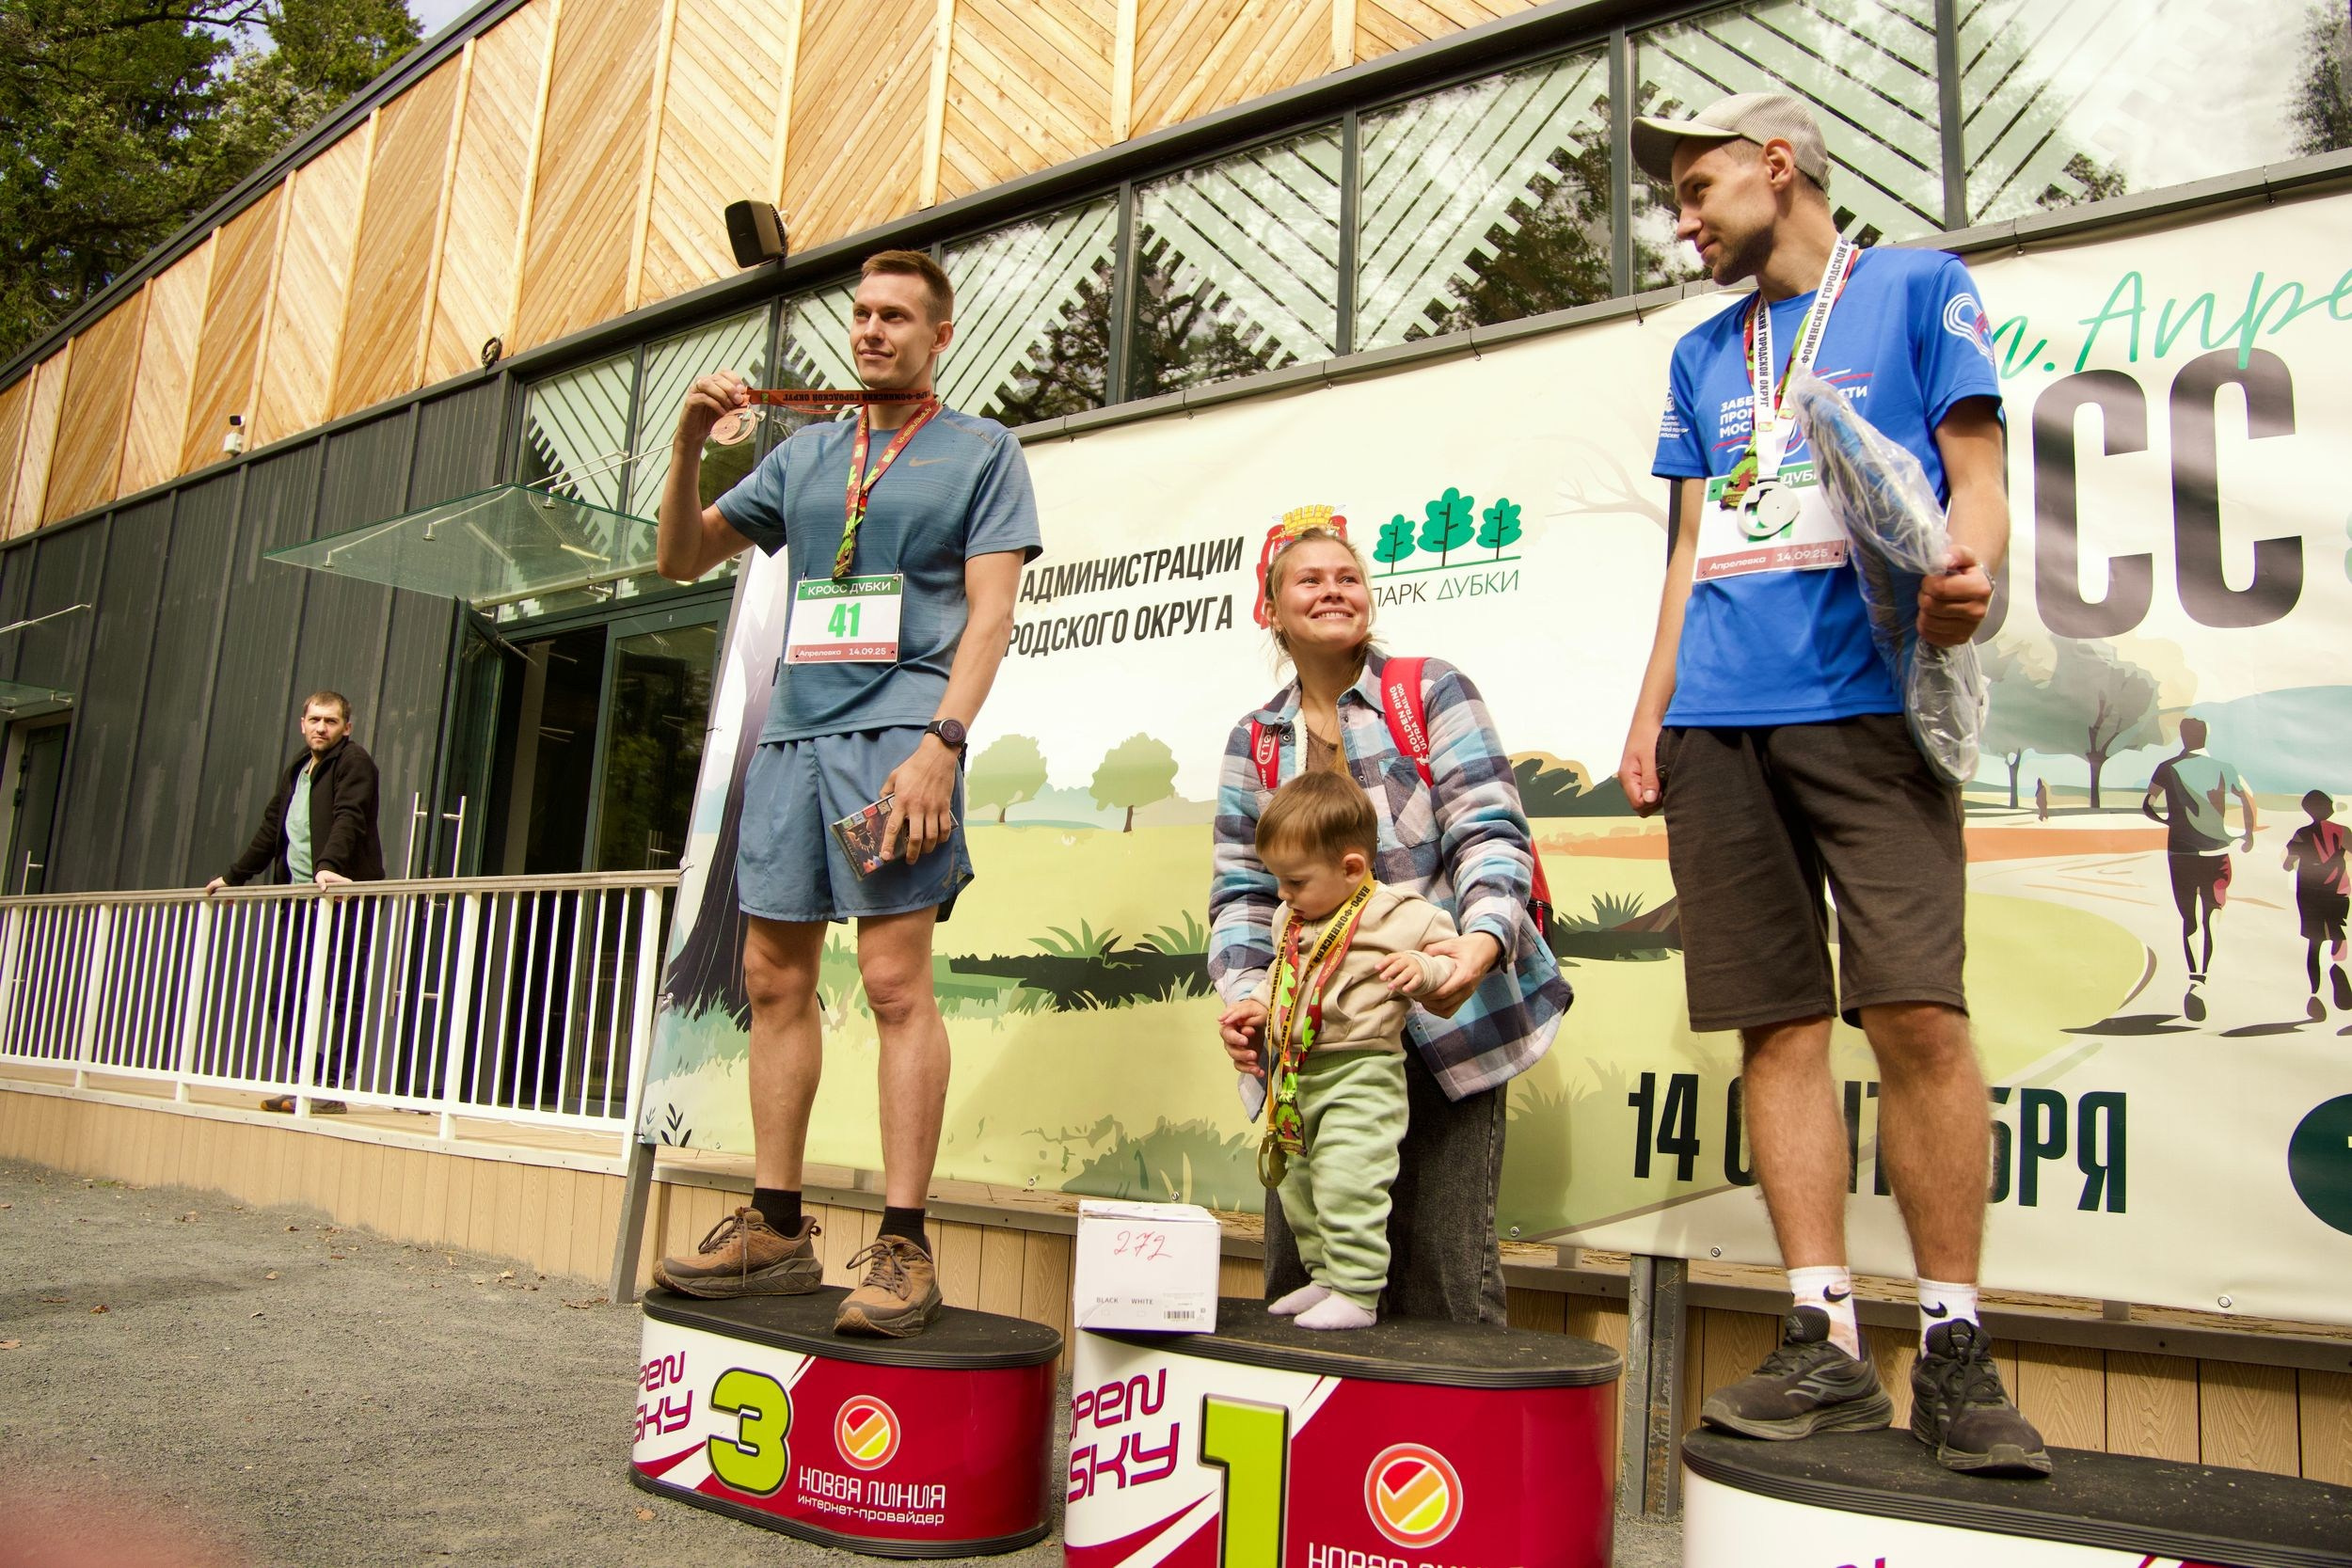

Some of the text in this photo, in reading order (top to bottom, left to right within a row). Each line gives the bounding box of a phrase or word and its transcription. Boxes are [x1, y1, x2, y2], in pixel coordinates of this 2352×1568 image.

[1821, 245, 1848, 299] ГОРОДСКОЙ
[1758, 331, 1769, 377] ГОРОДСКОЙ
[783, 393, 810, 402] ОКРУГ
[1760, 379, 1770, 407] ОКРУГ
[1019, 535, 1245, 605] АДМИНИСТРАЦИИ
[1709, 548, 1829, 572] Апрелевка 14.09.25
[807, 581, 891, 595] КРОСС ДУБКИ
[1437, 569, 1519, 600] ДУБКИ
[828, 602, 861, 638] 41
[1134, 594, 1233, 641] ОКРУГА
[849, 647, 887, 656] 14.09.25
[1390, 686, 1421, 752] GOLDEN RING
[1411, 721, 1427, 751] ULTRA
[1628, 1071, 1700, 1182] 14
[1114, 1229, 1173, 1261] 272
[707, 1367, 792, 1498] 3
[799, 1465, 946, 1510] НОВАЯ ЛИНИЯ
[1198, 1393, 1292, 1568] 1
[798, 1494, 945, 1527] интернет-провайдер
